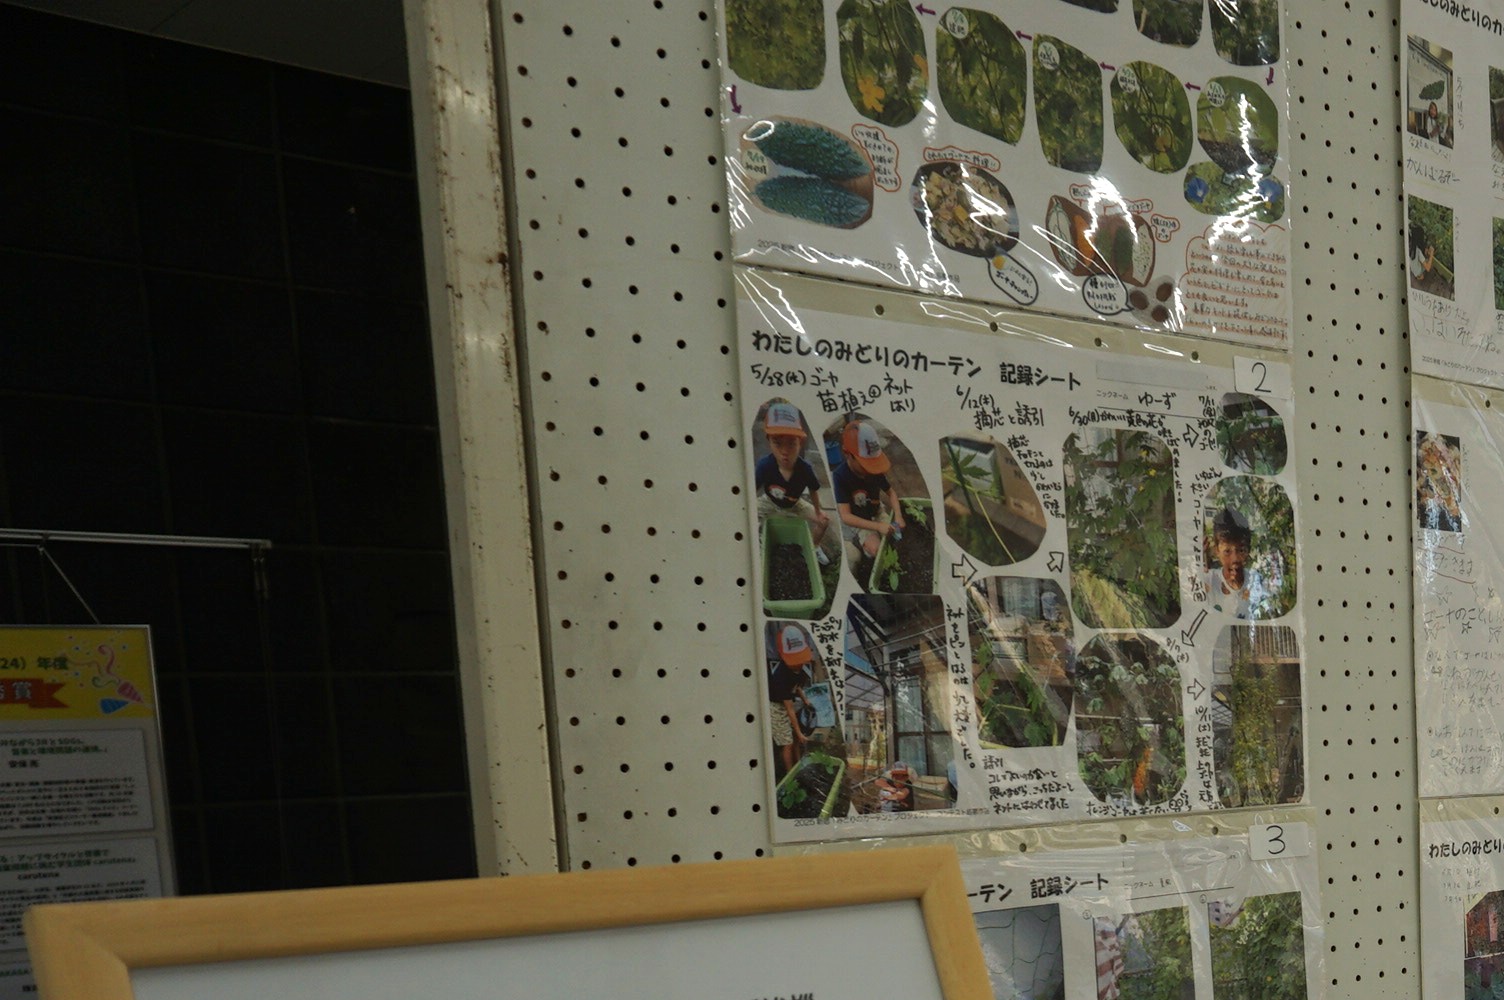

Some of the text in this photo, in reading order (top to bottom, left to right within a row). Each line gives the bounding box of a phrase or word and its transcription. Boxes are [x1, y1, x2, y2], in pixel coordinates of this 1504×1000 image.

[751, 328, 1082, 392] わたしのみどりのカーテン 記録シート
[1251, 361, 1272, 393] 2
[1265, 825, 1286, 855] 3
[1029, 873, 1110, 900] 記録シート
